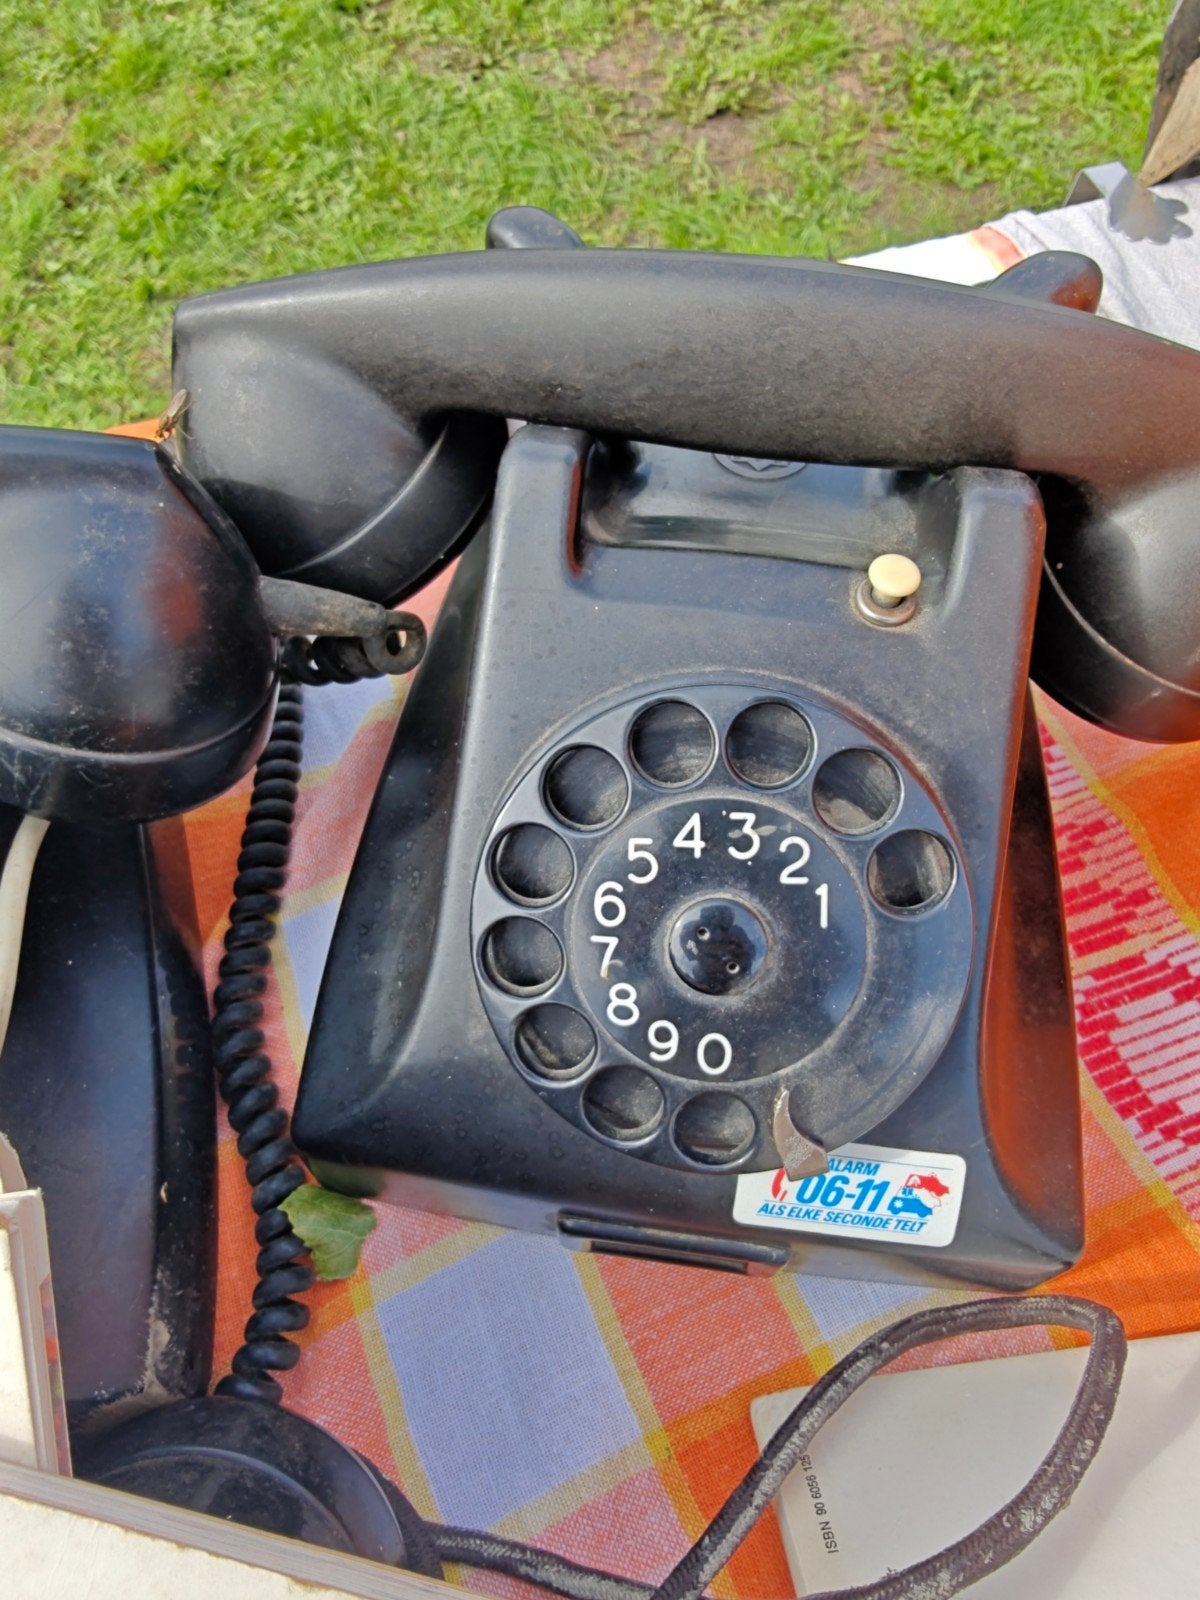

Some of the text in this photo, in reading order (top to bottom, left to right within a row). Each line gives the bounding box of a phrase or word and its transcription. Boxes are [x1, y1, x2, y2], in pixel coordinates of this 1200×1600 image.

[672, 812, 706, 859] 4
[727, 812, 761, 860] 3
[627, 837, 659, 884] 5
[779, 836, 810, 885] 2
[593, 881, 626, 927] 6
[815, 883, 829, 929] 1
[590, 935, 619, 978] 7
[606, 982, 640, 1027] 8
[648, 1020, 679, 1062] 9
[696, 1032, 733, 1076] 0
[828, 1158, 880, 1175] ALARM
[795, 1174, 890, 1212] 06-11
[757, 1202, 927, 1232] ALS ELKE SECONDE TELT
[814, 1502, 827, 1516] 90
[819, 1521, 839, 1554] ISBN
